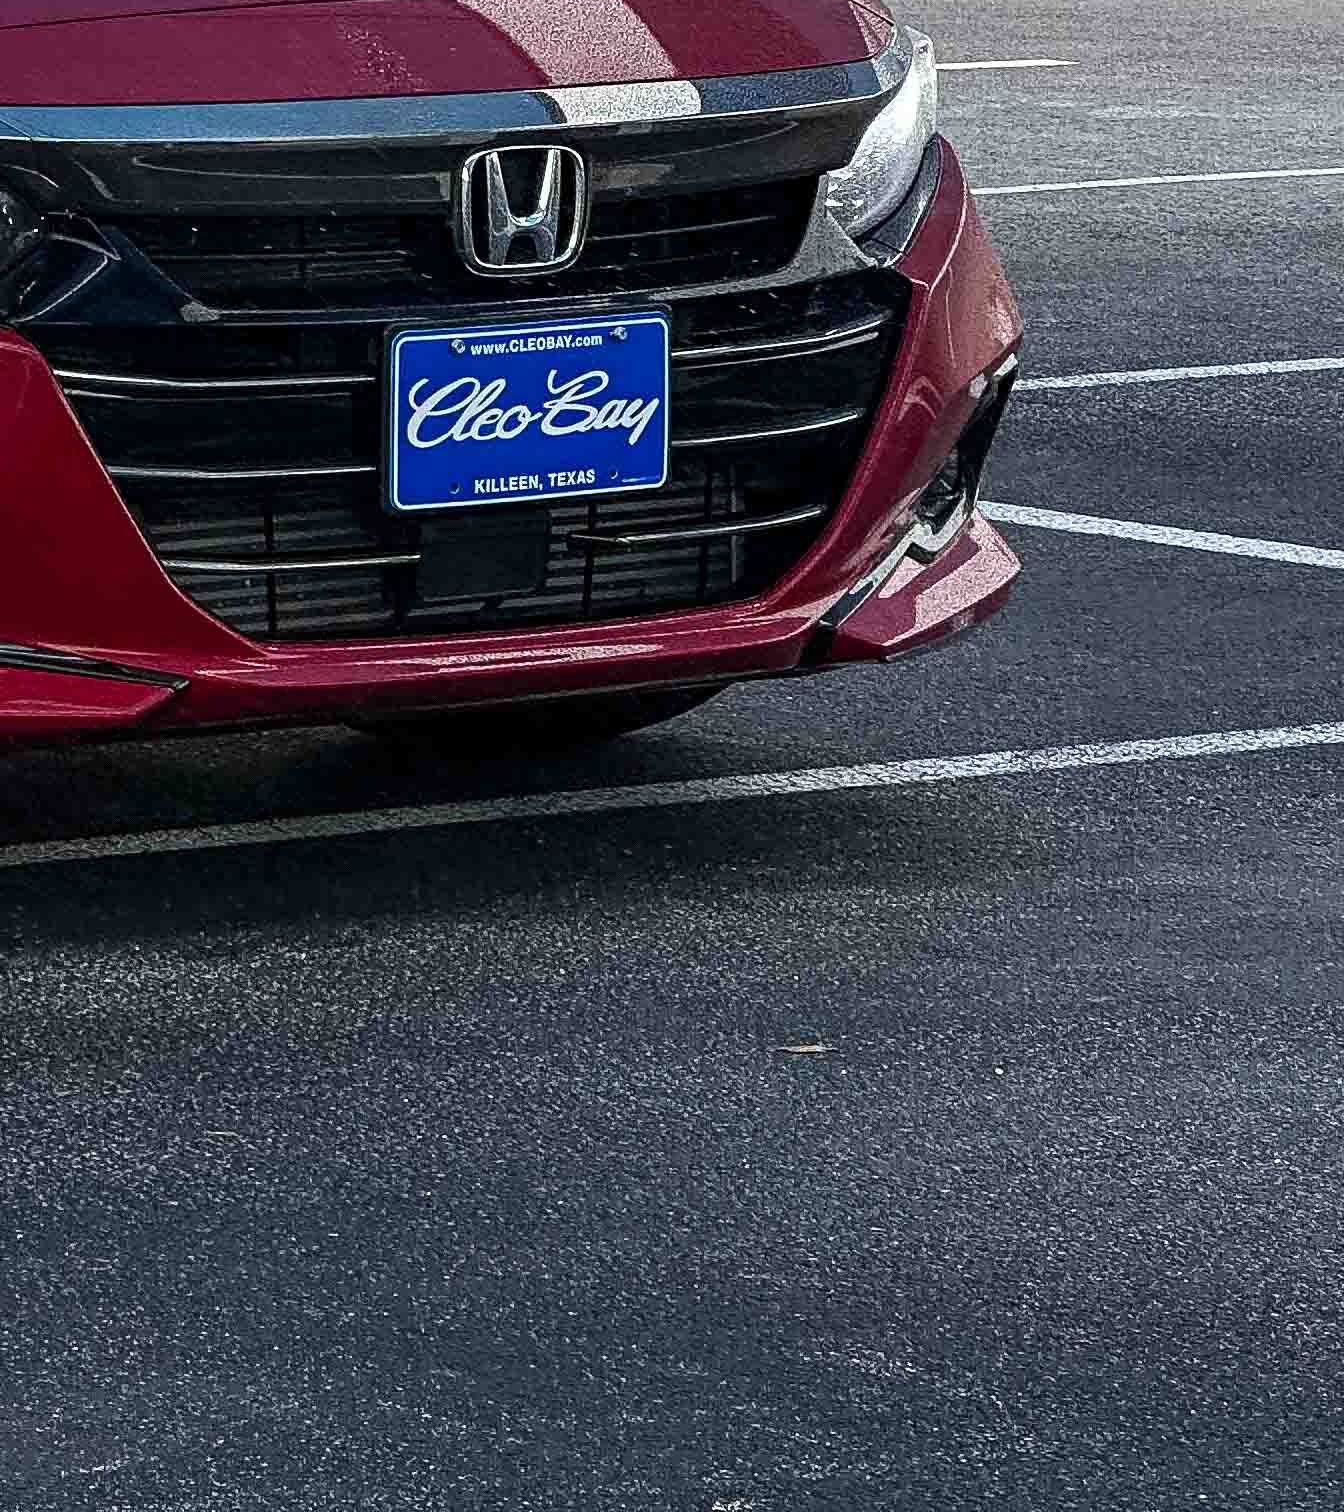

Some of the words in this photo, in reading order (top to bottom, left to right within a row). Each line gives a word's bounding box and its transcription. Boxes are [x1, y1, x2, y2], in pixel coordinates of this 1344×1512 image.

[470, 334, 603, 356] www.CLEOBAY.com
[407, 376, 543, 449] Cleo
[540, 368, 660, 446] Bay
[474, 477, 543, 495] KILLEEN,
[547, 468, 596, 487] TEXAS
